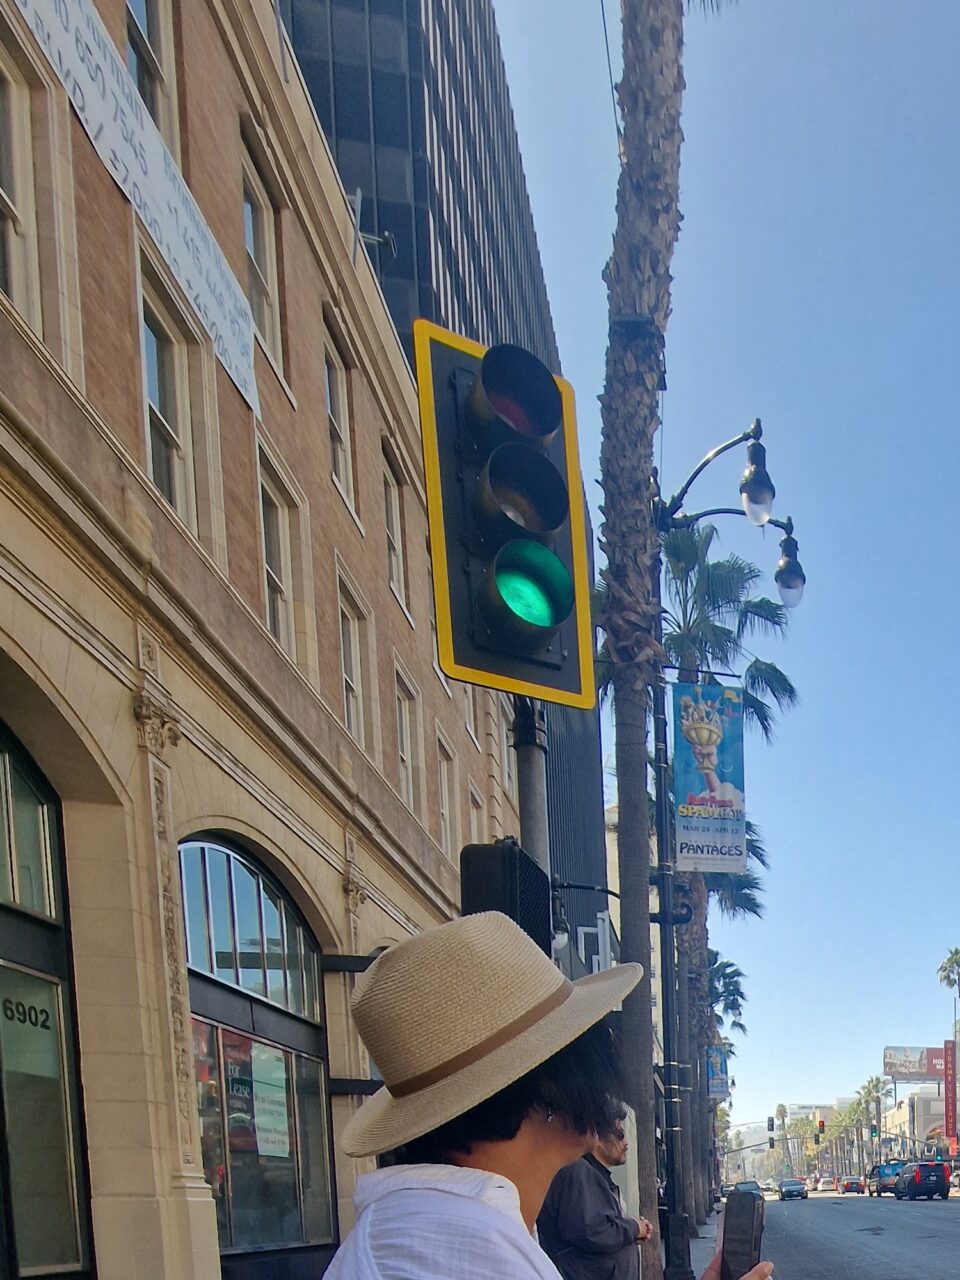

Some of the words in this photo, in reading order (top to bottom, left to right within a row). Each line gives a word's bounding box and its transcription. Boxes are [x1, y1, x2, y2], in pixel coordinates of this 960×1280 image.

[75, 26, 106, 100] 650
[111, 89, 148, 177] 7545
[680, 842, 743, 857] PANTAGES
[3, 998, 51, 1030] 6902
[228, 1059, 240, 1078] For
[229, 1077, 250, 1099] Lease
